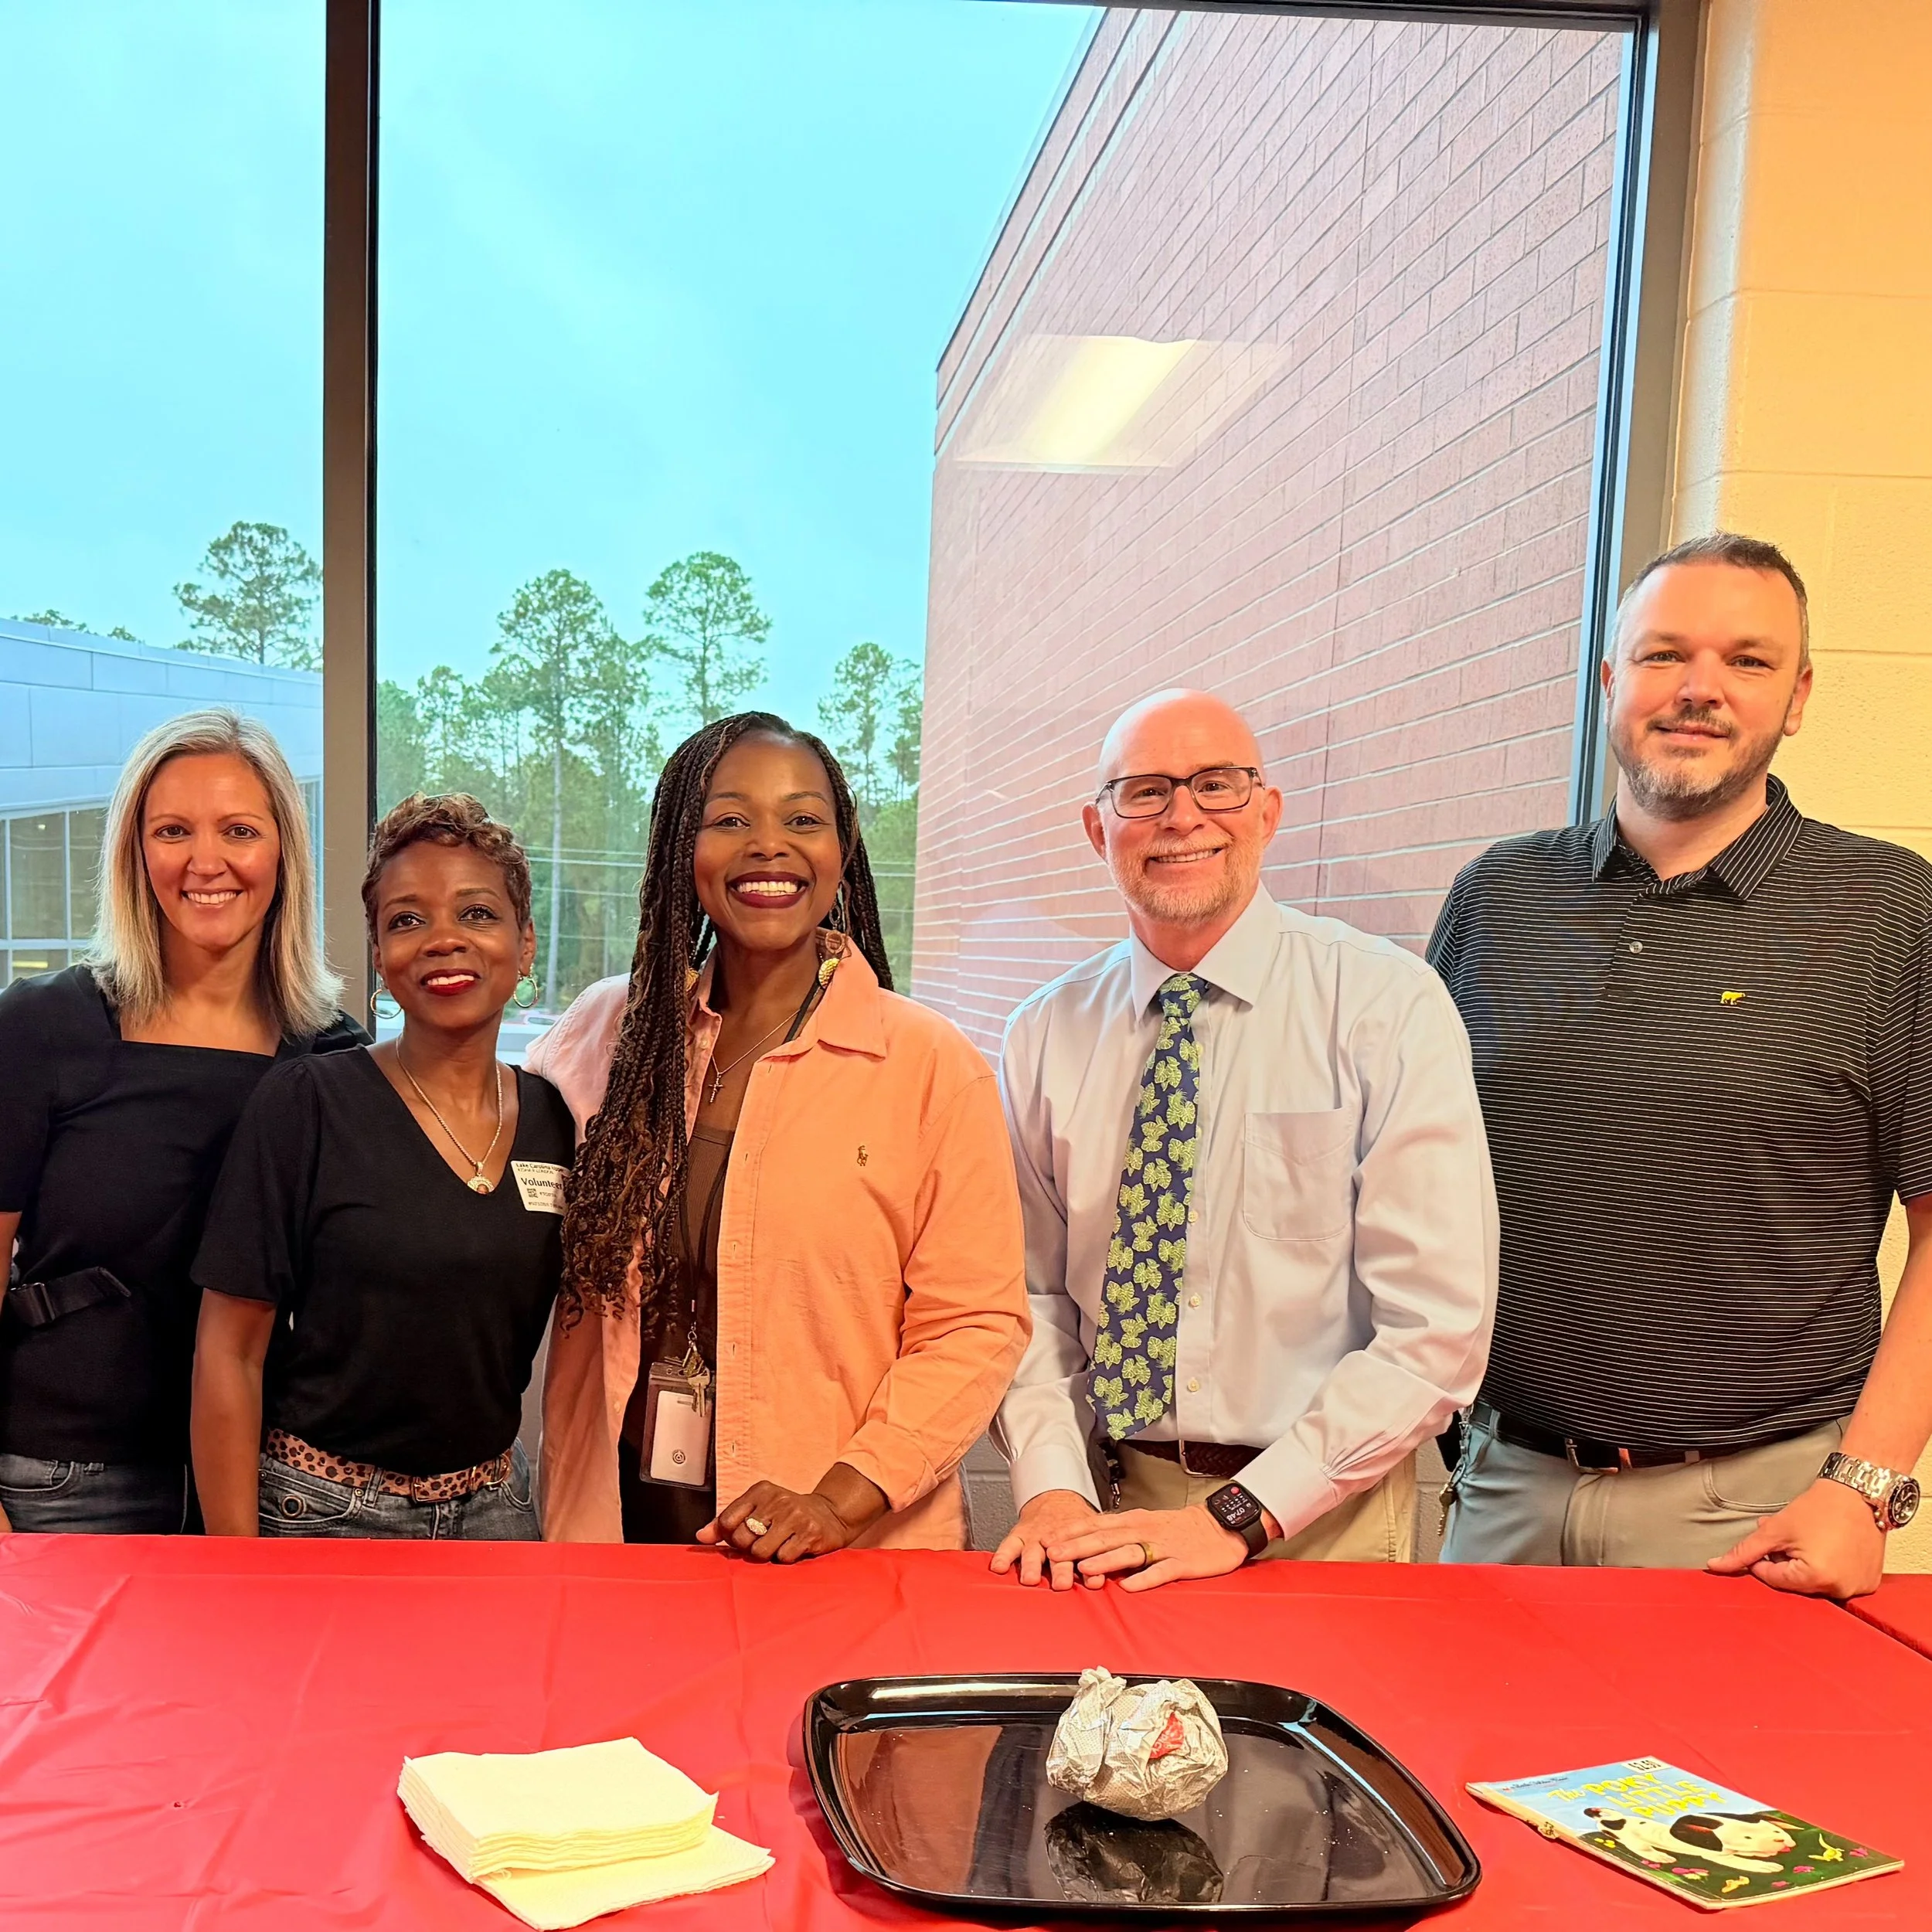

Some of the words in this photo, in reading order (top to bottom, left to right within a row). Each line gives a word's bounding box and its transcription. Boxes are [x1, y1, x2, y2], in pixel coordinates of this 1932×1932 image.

[520, 1177, 563, 1190] Volunteer
[1546, 1787, 1586, 1802] The
[1583, 1772, 1662, 1796] POKY
[1604, 1780, 1706, 1809] LITTLE
[1631, 1791, 1726, 1819] PUPPY
